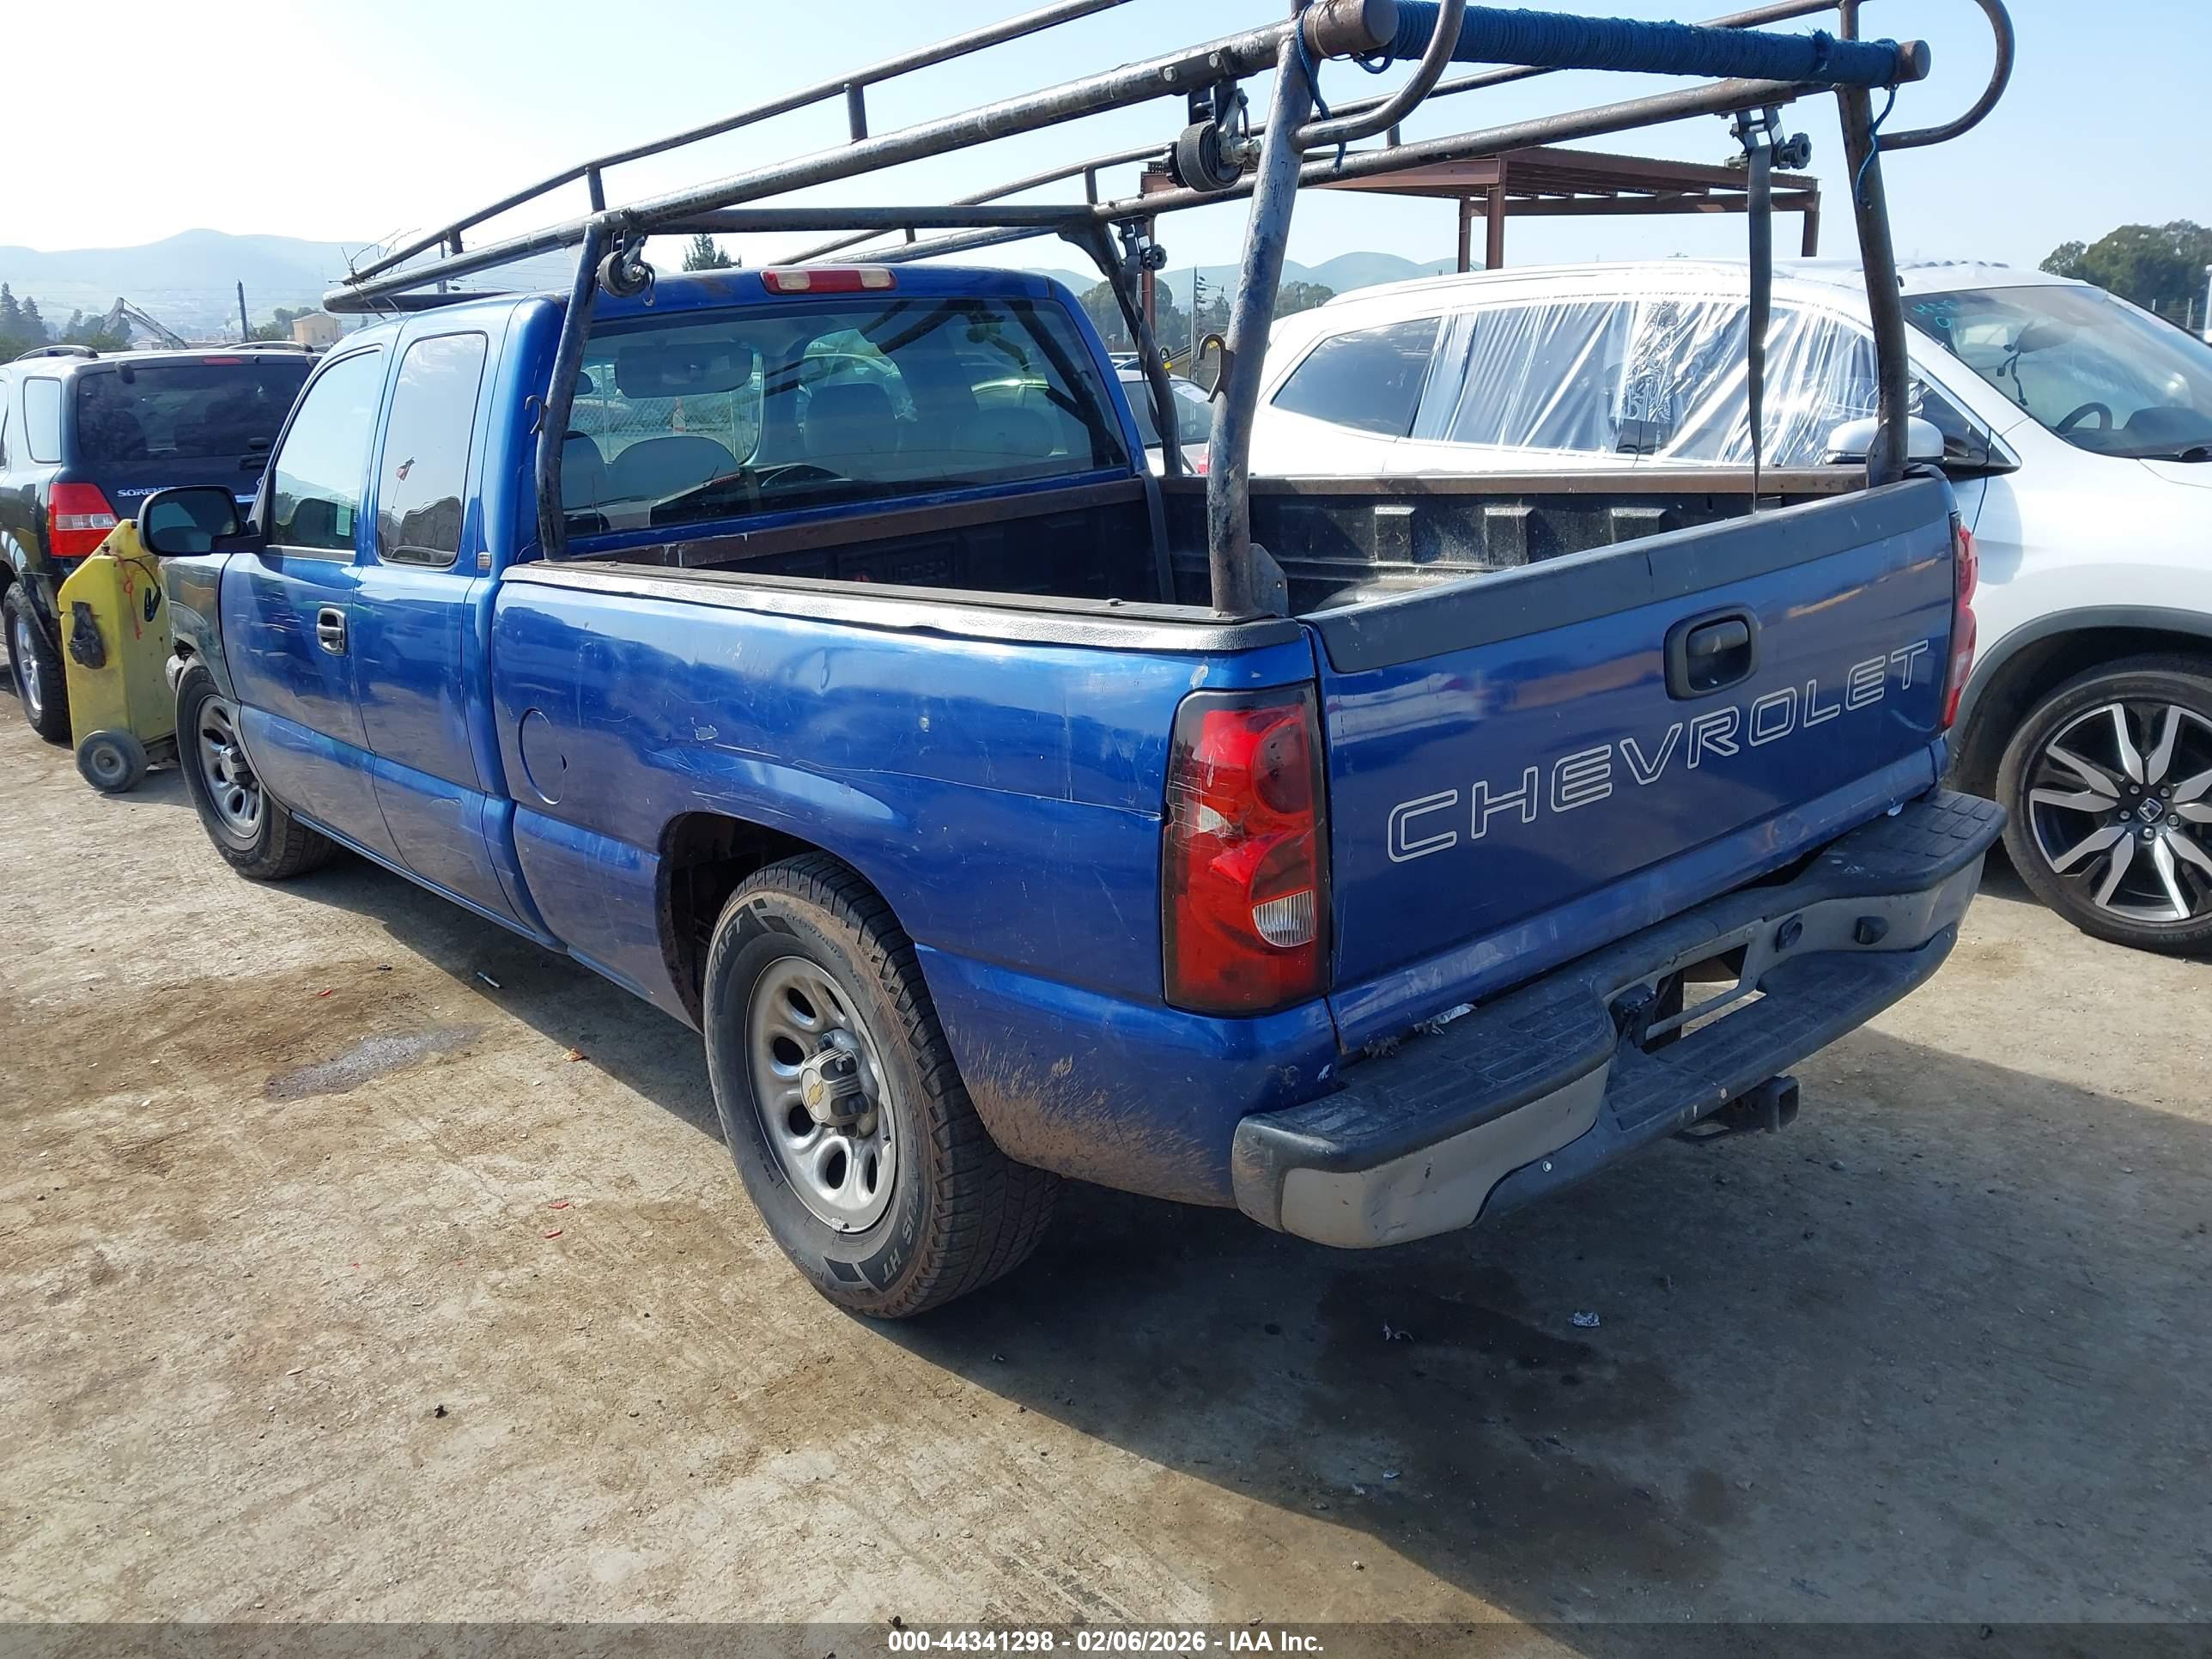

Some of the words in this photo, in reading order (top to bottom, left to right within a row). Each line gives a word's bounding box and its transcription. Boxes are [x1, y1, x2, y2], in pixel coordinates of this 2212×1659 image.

[117, 487, 166, 497] SOREN
[1387, 640, 1929, 863] CHEVROLET
[883, 1249, 902, 1283] HT
